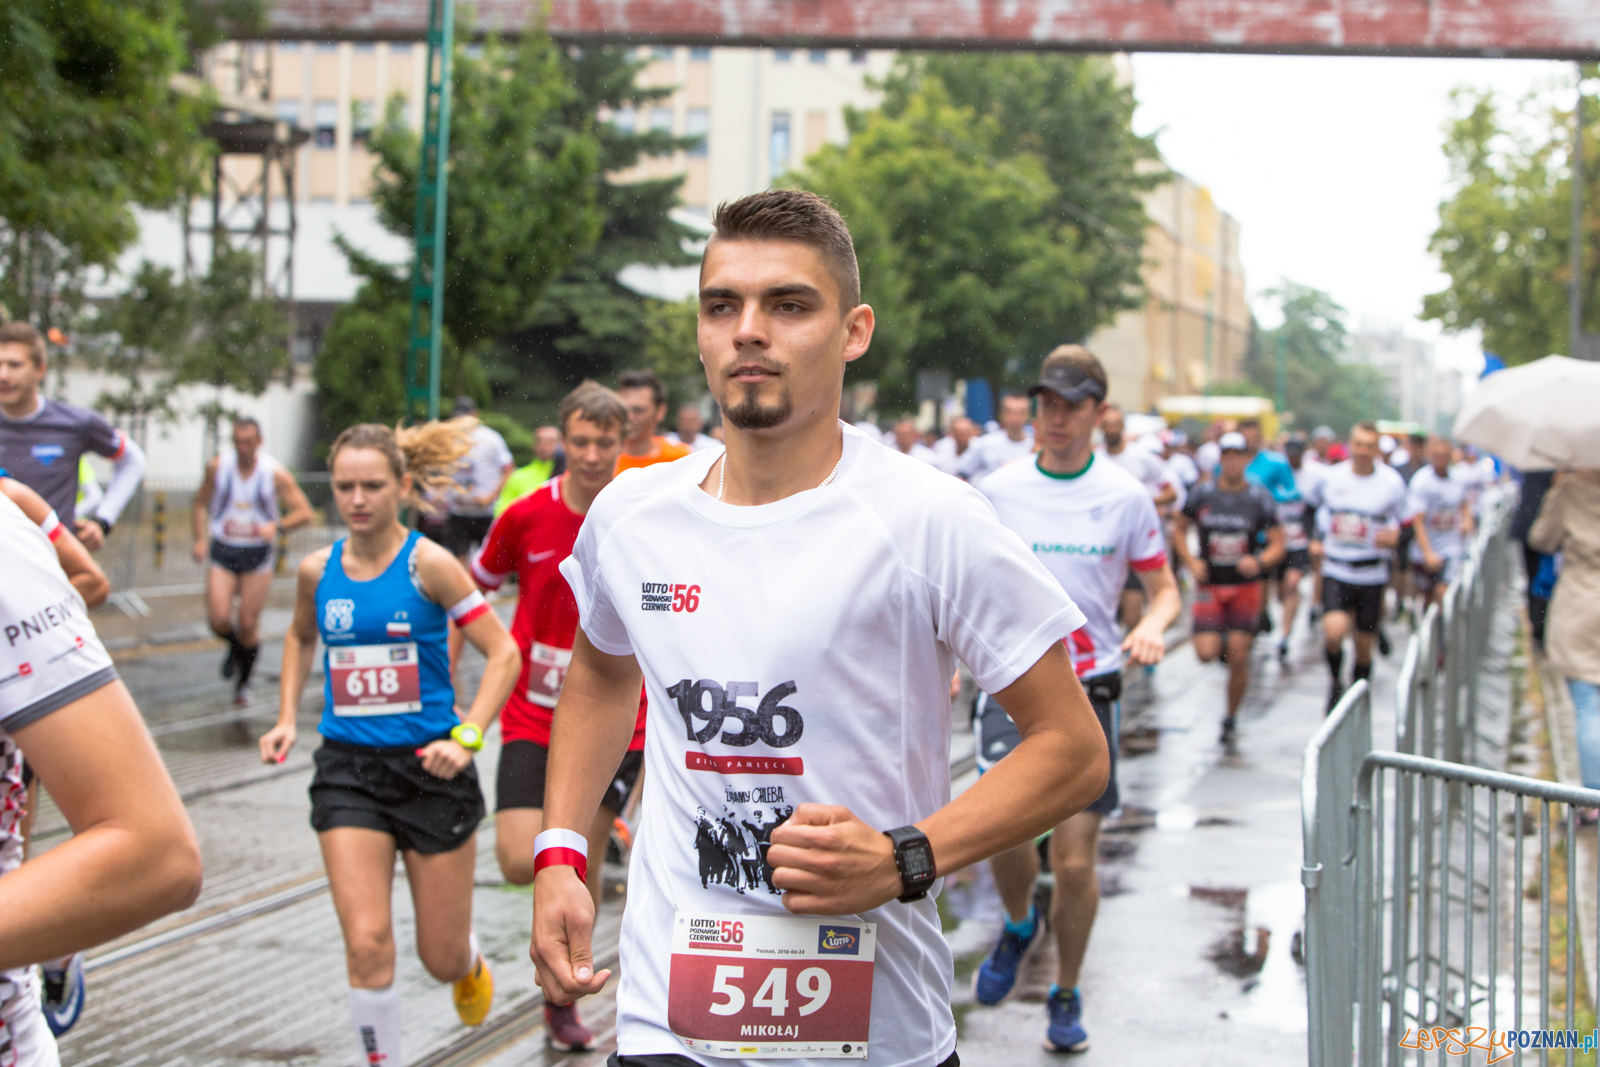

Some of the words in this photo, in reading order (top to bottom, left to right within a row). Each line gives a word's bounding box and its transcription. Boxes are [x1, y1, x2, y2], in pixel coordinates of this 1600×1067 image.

[642, 582, 669, 594] LOTTO
[641, 593, 673, 603] POZNAŃSKI
[641, 602, 671, 611] CZERWIEC
[346, 667, 400, 697] 618
[665, 678, 804, 748] 1956
[727, 761, 785, 770] PAMIĘCI
[690, 918, 715, 928] LOTTO
[689, 927, 720, 935] POZNAŃSKI
[689, 934, 720, 942] CZERWIEC
[829, 937, 850, 946] LOTTO
[708, 964, 832, 1017] 549
[740, 1024, 799, 1039] MIKOŁAJ
